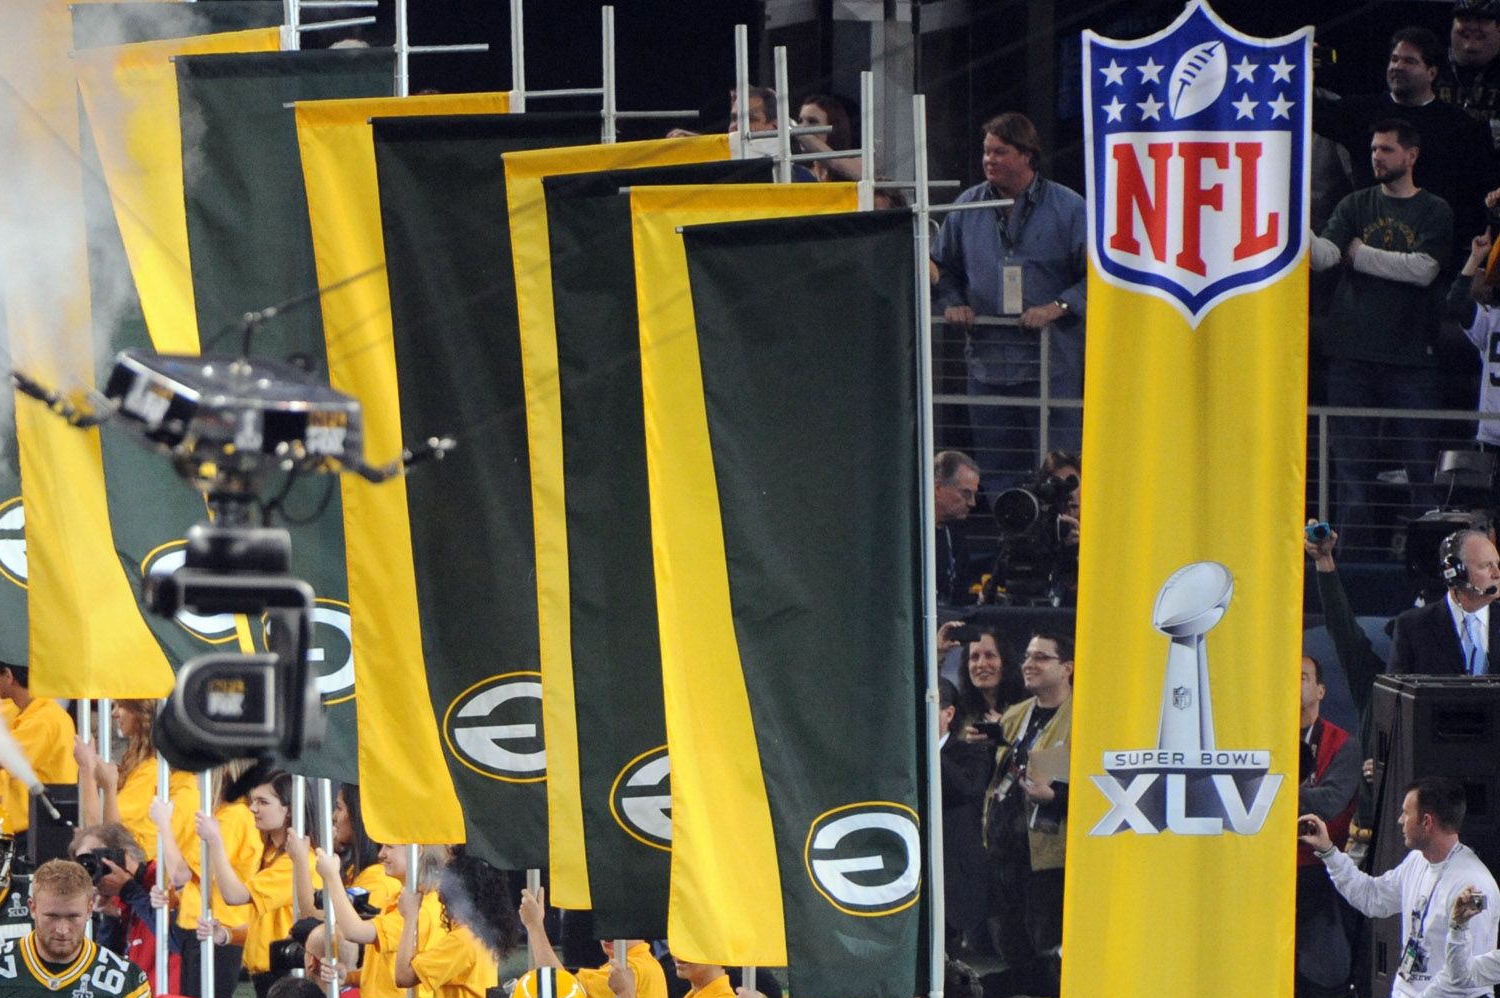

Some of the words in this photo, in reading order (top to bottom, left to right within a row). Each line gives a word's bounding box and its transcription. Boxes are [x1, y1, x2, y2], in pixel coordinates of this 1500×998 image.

[1110, 142, 1280, 278] NFL
[1115, 752, 1185, 766] SUPER
[1200, 752, 1261, 766] BOWL
[1087, 773, 1284, 836] XLV
[91, 946, 130, 994] 67
